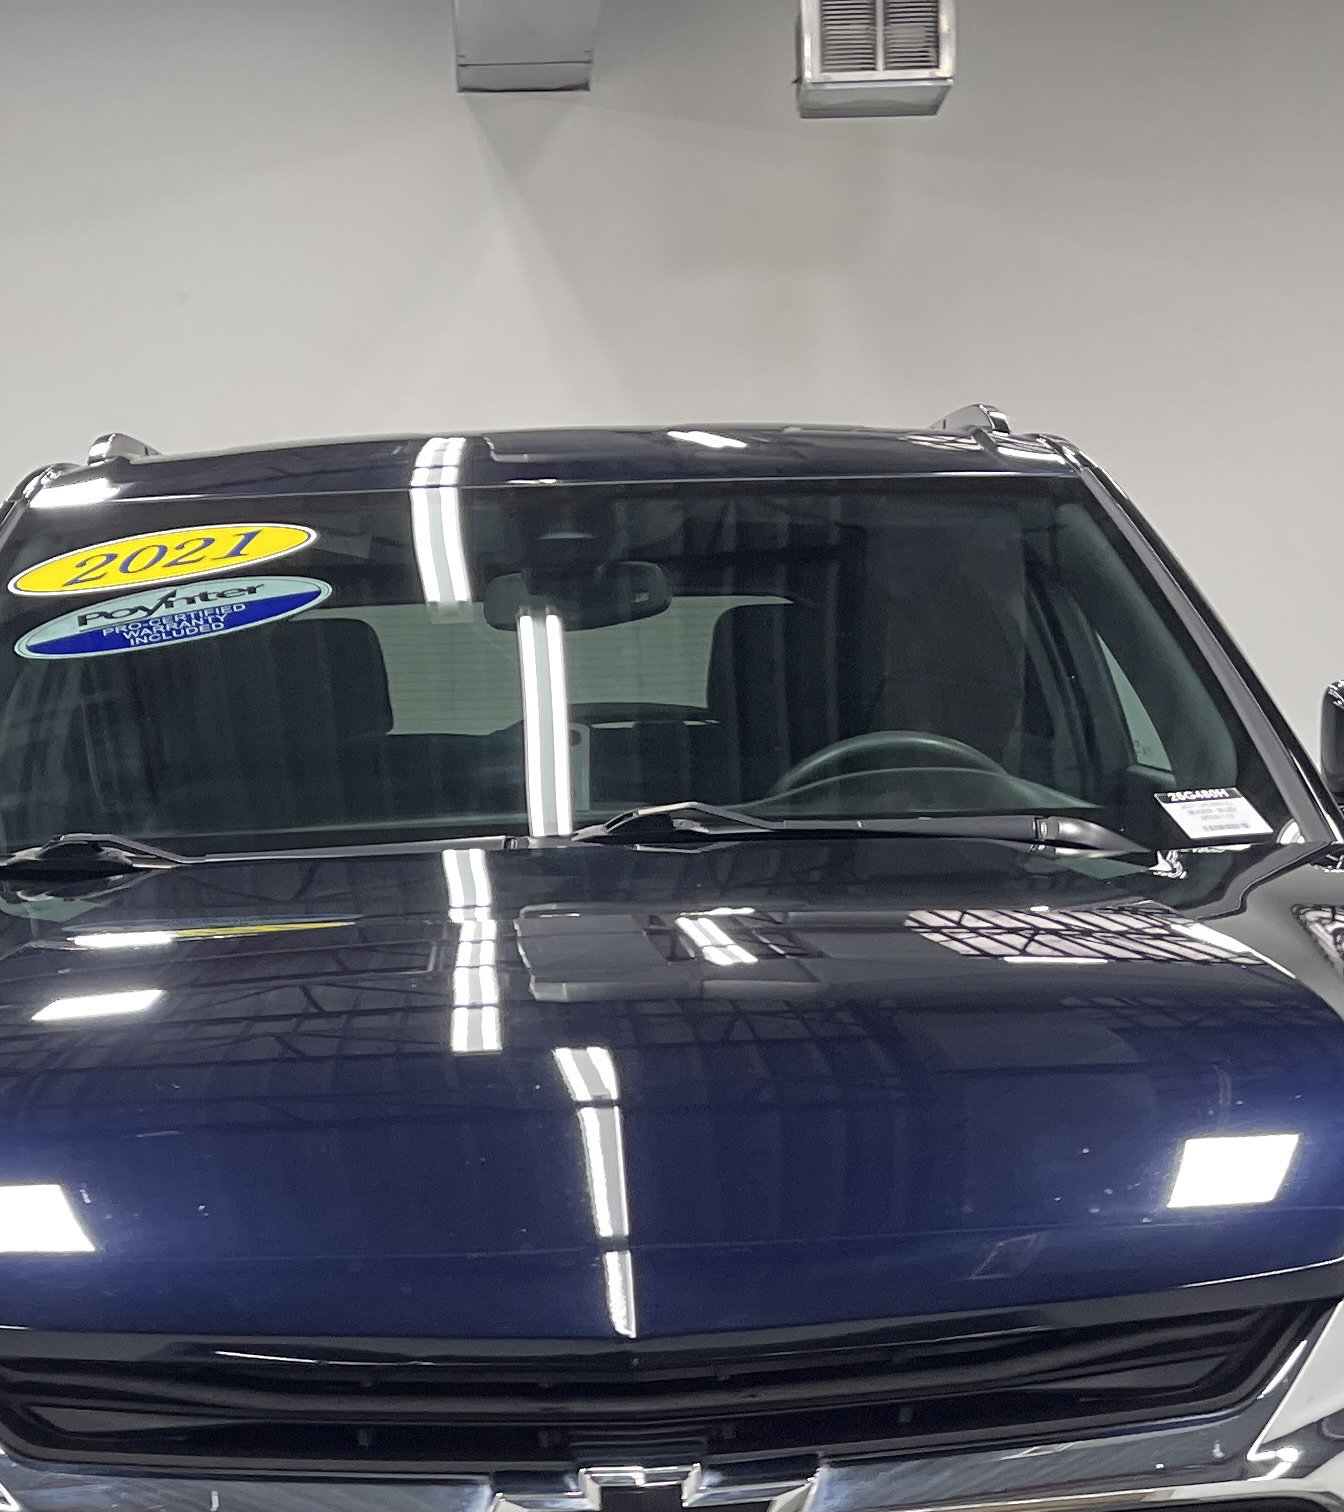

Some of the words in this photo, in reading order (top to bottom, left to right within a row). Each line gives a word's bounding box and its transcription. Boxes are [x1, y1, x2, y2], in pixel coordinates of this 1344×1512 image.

[62, 530, 264, 586] 2021
[77, 584, 265, 626] Poynter
[103, 604, 246, 637] PRO-CERTIFIED
[122, 614, 228, 639] WARRANTY
[129, 623, 224, 646] INCLUDED
